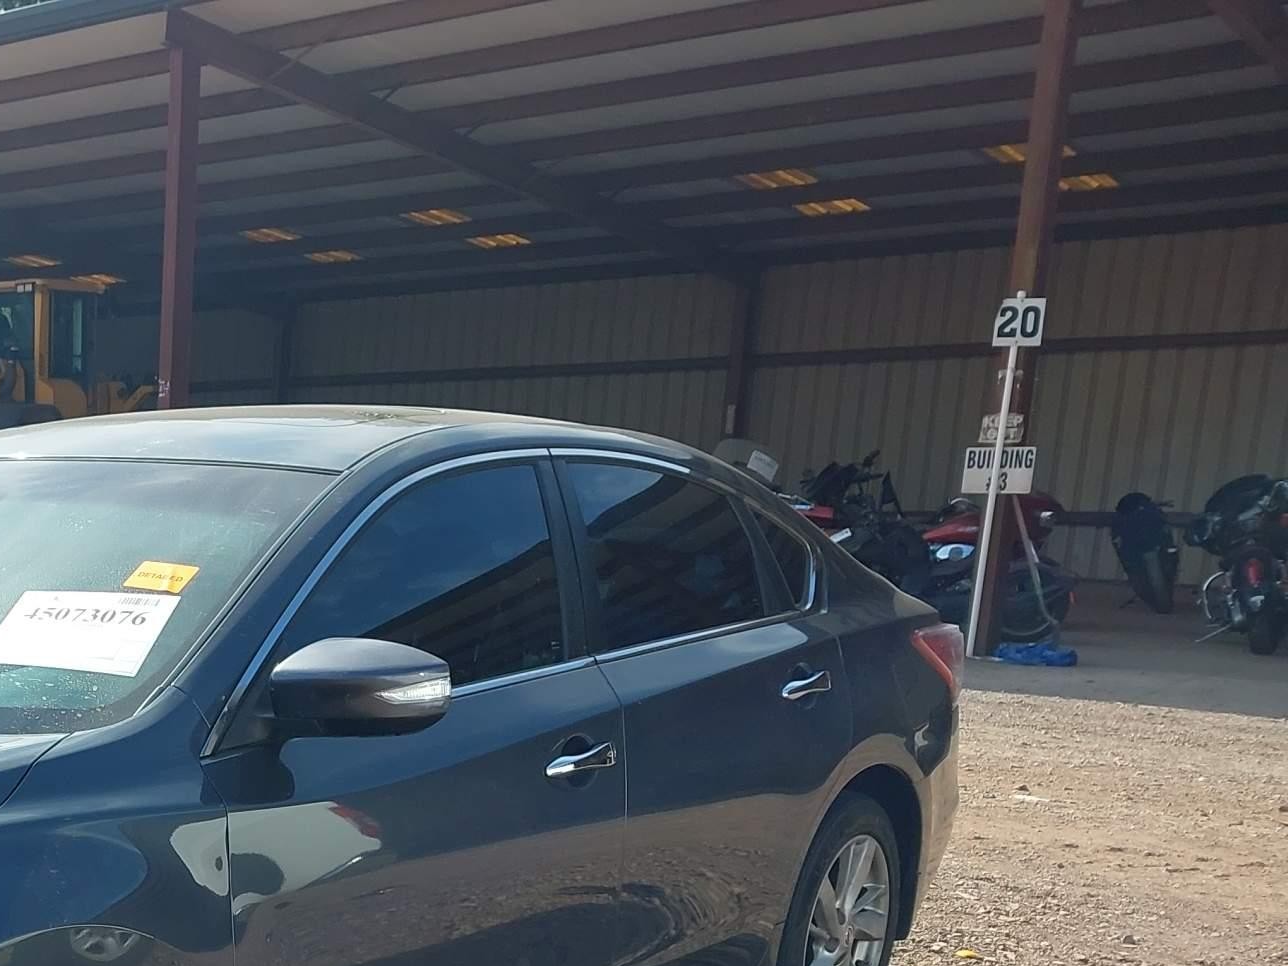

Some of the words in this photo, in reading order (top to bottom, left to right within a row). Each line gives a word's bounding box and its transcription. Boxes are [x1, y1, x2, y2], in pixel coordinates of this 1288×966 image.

[996, 305, 1041, 338] 20
[986, 428, 1018, 440] OT
[24, 607, 152, 626] 45073076
